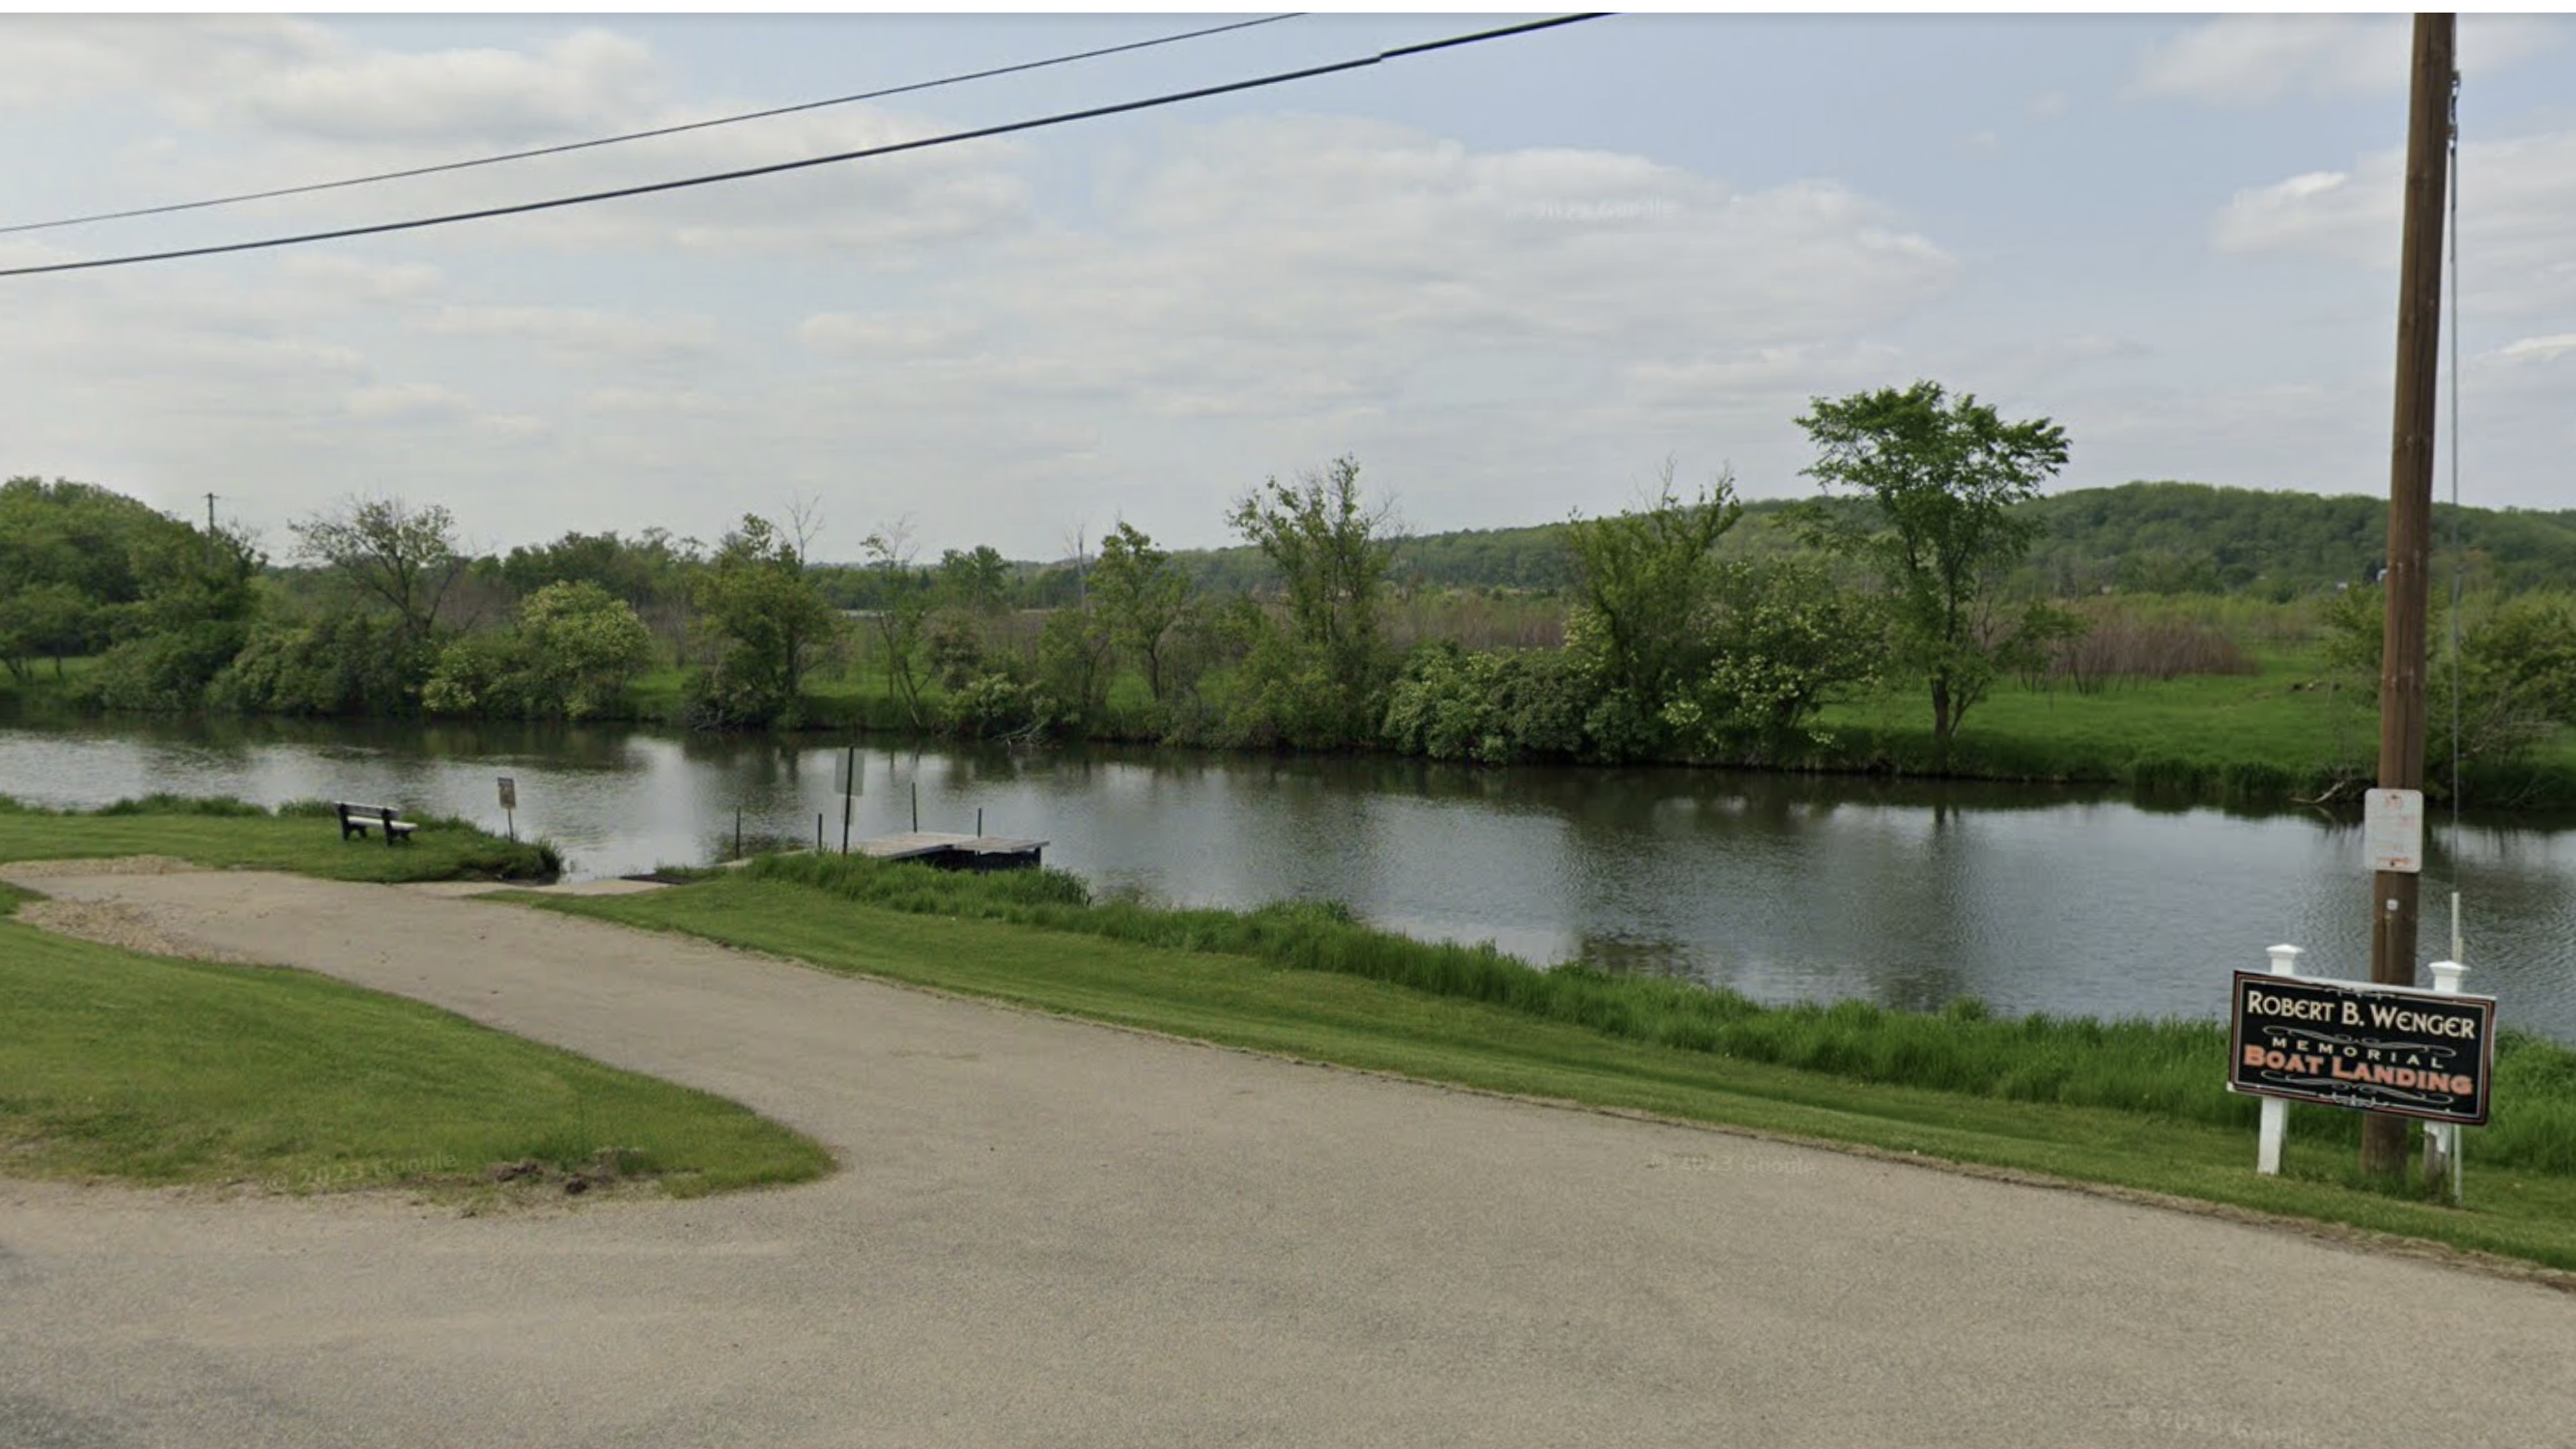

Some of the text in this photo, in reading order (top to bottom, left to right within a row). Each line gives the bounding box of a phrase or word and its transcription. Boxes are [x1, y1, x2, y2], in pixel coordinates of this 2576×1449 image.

[2247, 990, 2476, 1039] ROBERT B. WENGER
[2244, 1044, 2473, 1095] BOAT LANDING
[2272, 1036, 2444, 1069] MEMORIAL
